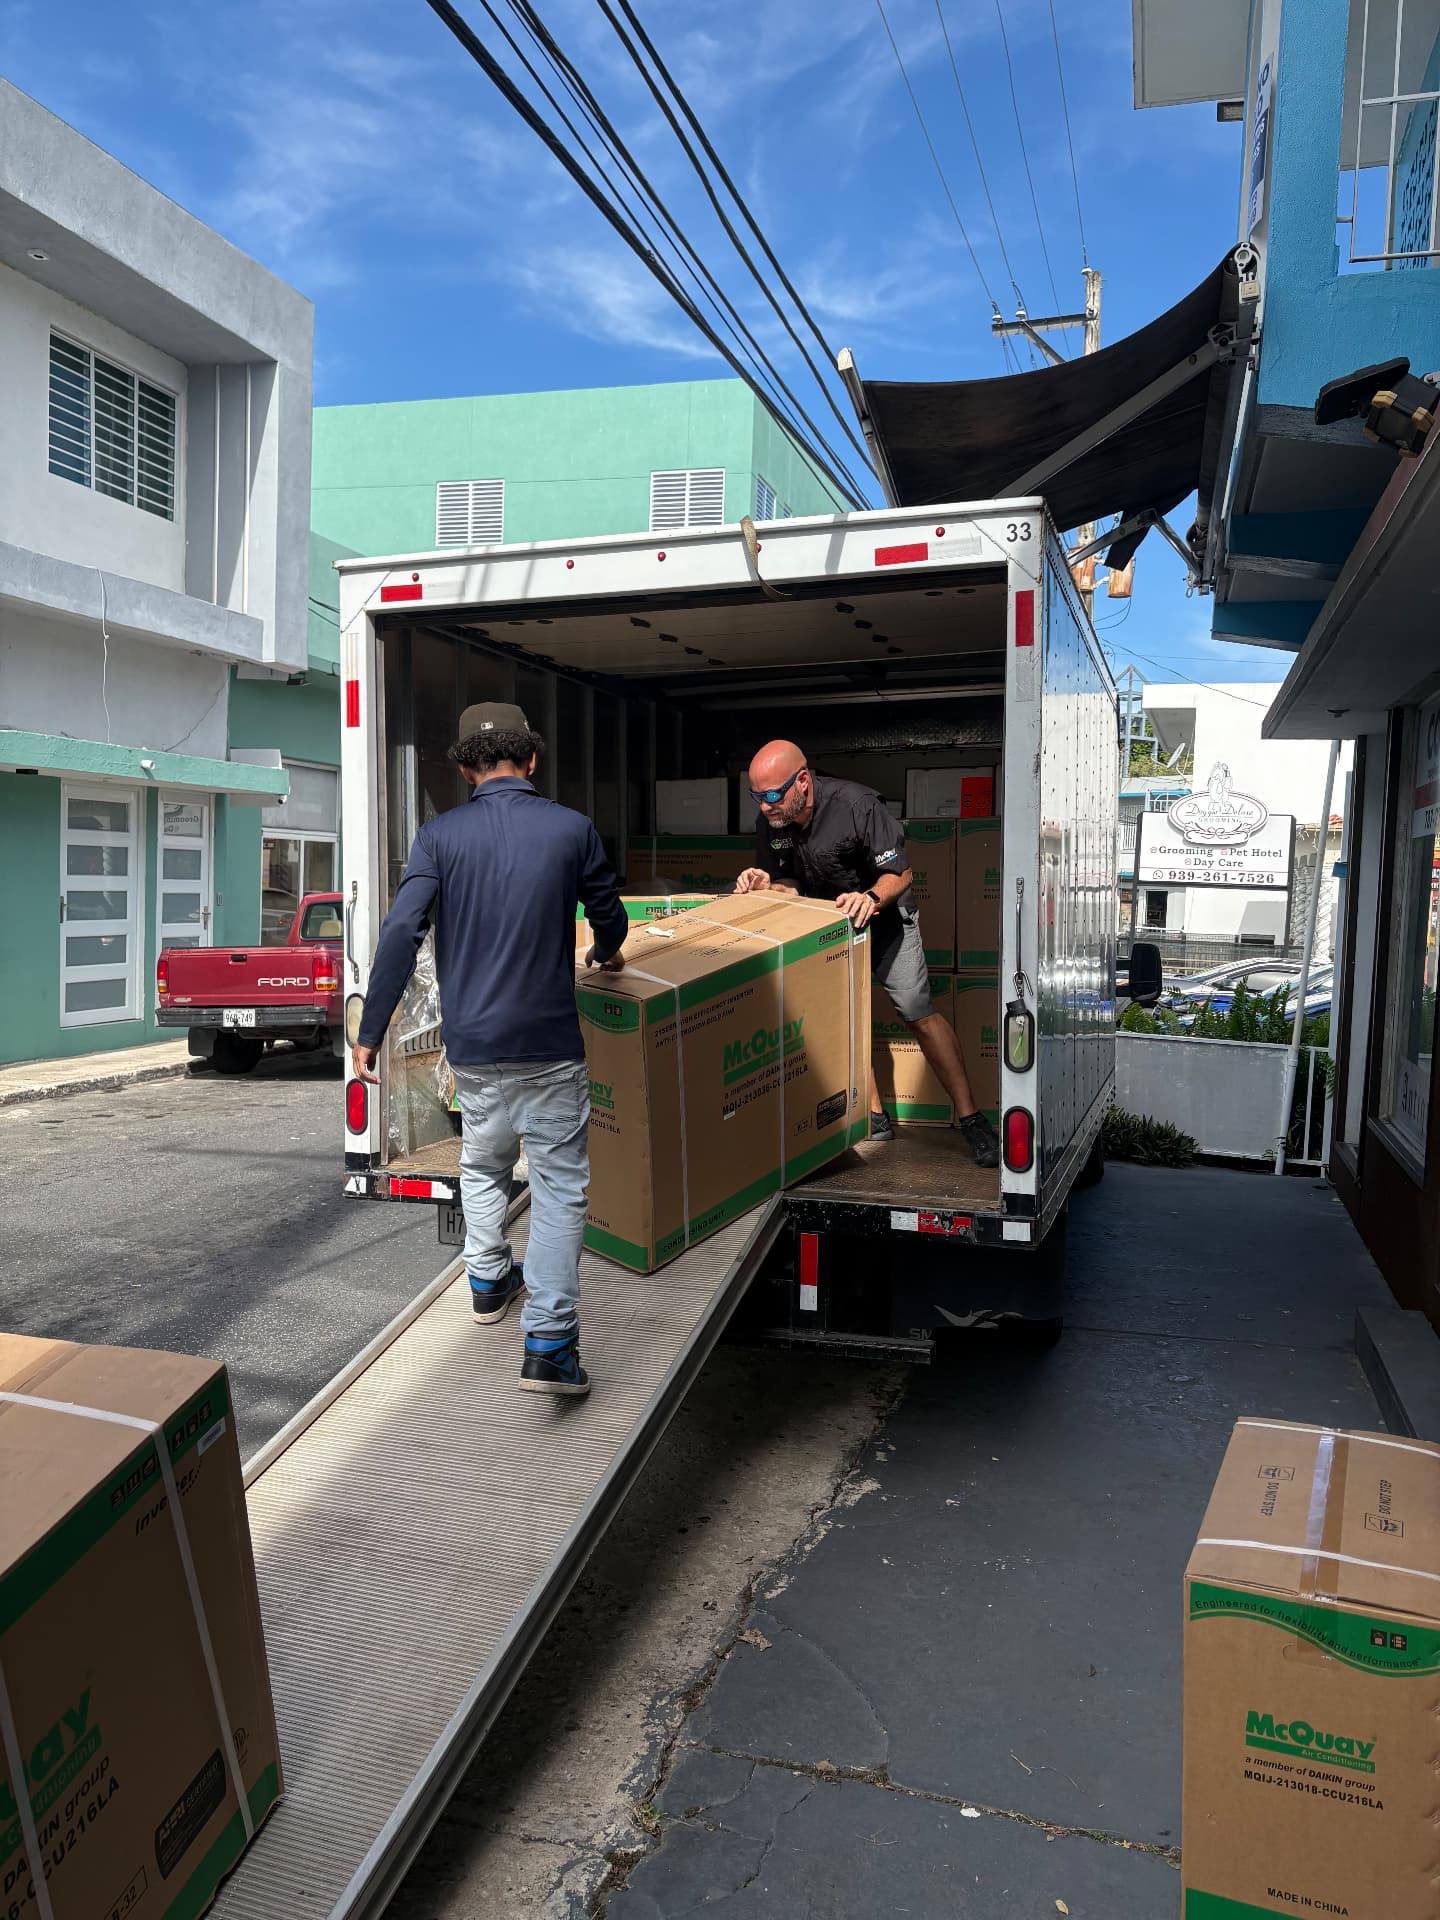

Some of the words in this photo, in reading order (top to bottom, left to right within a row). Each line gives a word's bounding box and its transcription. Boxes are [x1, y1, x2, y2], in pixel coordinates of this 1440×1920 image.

[1007, 522, 1032, 543] 33
[1159, 846, 1214, 858] Grooming
[1229, 848, 1248, 857] Pet
[1252, 849, 1283, 858] Hotel
[1194, 858, 1215, 869] Day
[1219, 858, 1244, 868] Care
[1169, 871, 1275, 884] 939-261-7526
[257, 977, 310, 987] FORD
[723, 1017, 804, 1072] McQuay
[731, 1078, 757, 1096] member
[1380, 1480, 1392, 1493] STEP
[1195, 1599, 1257, 1612] Engineered
[1259, 1605, 1277, 1617] for
[1278, 1610, 1328, 1642] flexibility
[1328, 1640, 1349, 1655] and
[1246, 1711, 1375, 1760] McQuay
[1302, 1750, 1314, 1758] Air
[1316, 1752, 1372, 1772] Conditioning
[1254, 1758, 1295, 1773] member
[1296, 1767, 1307, 1777] of
[1309, 1769, 1343, 1784] DAIKIN
[1345, 1779, 1376, 1793] group
[65, 1756, 110, 1822] group
[1267, 1888, 1299, 1903] MADE
[1301, 1897, 1312, 1907] IN
[1314, 1900, 1349, 1917] CHINA
